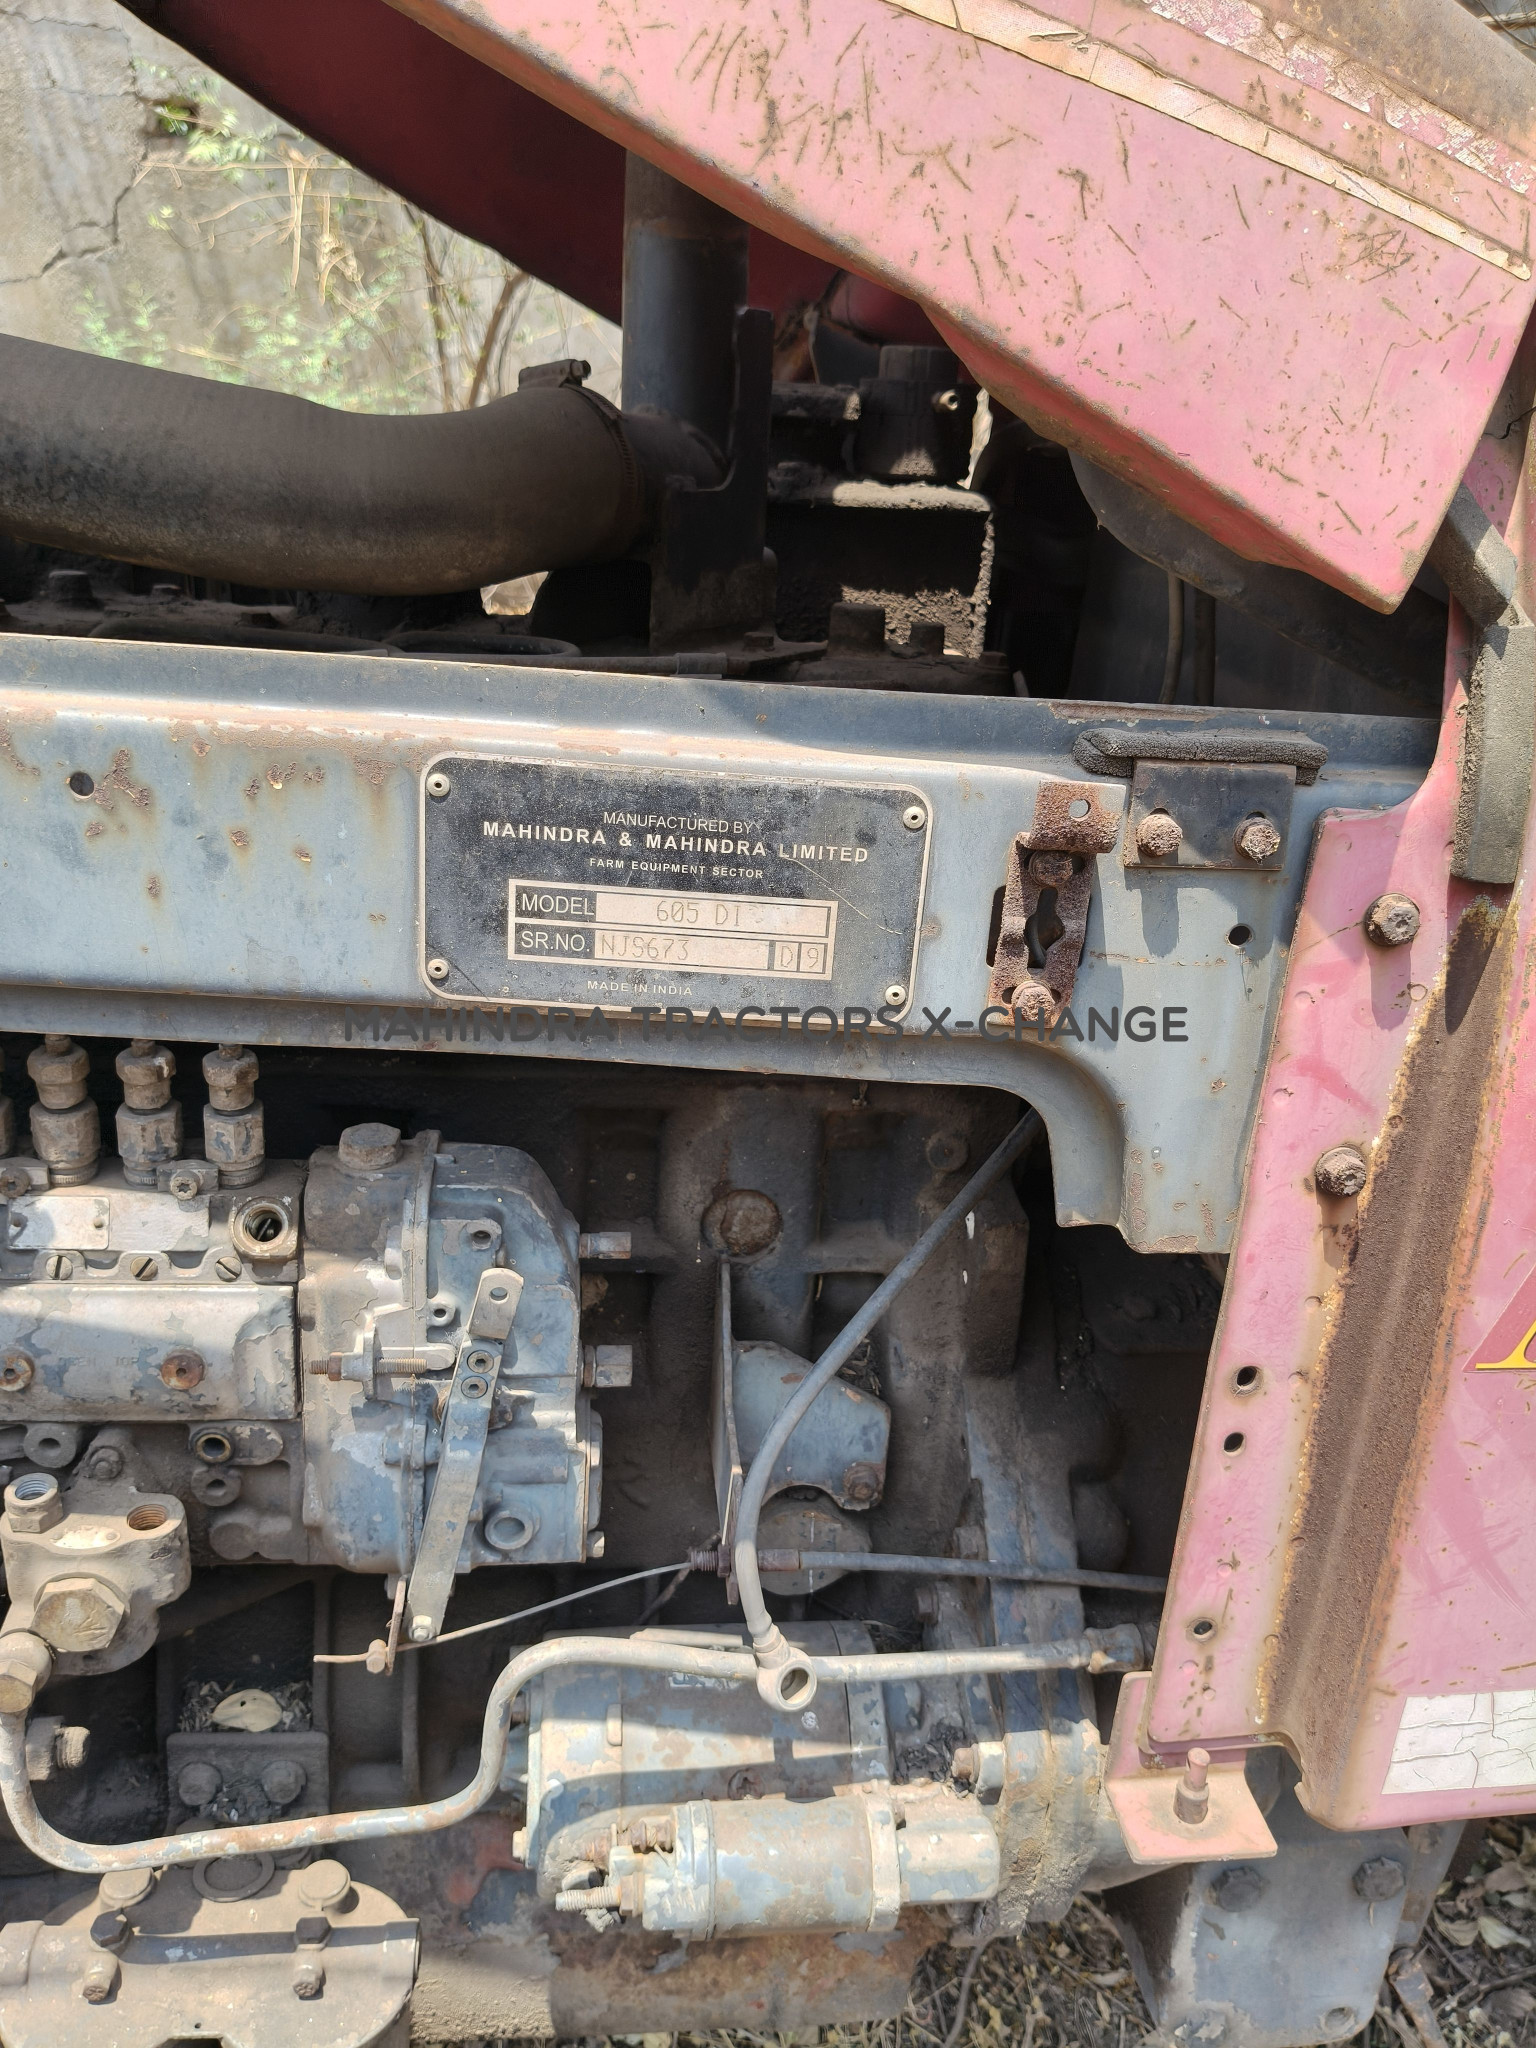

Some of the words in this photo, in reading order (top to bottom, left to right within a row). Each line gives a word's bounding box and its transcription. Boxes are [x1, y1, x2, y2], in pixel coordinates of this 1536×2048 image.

[603, 811, 729, 833] MANUFACTURED
[733, 821, 754, 834] BY
[483, 821, 607, 845] MAHINDRA
[618, 831, 633, 847] &
[646, 833, 767, 857] MAHINDRA
[779, 843, 868, 863] LIMITED
[590, 857, 625, 869] FARM
[631, 860, 706, 875] EQUIPMENT
[712, 867, 764, 879] SECTOR
[521, 893, 595, 916] MODEL
[656, 900, 700, 924] 605
[520, 930, 590, 952] SR.NO.
[587, 980, 629, 992] MADE
[634, 983, 649, 993] IN
[653, 984, 693, 996] INDIA
